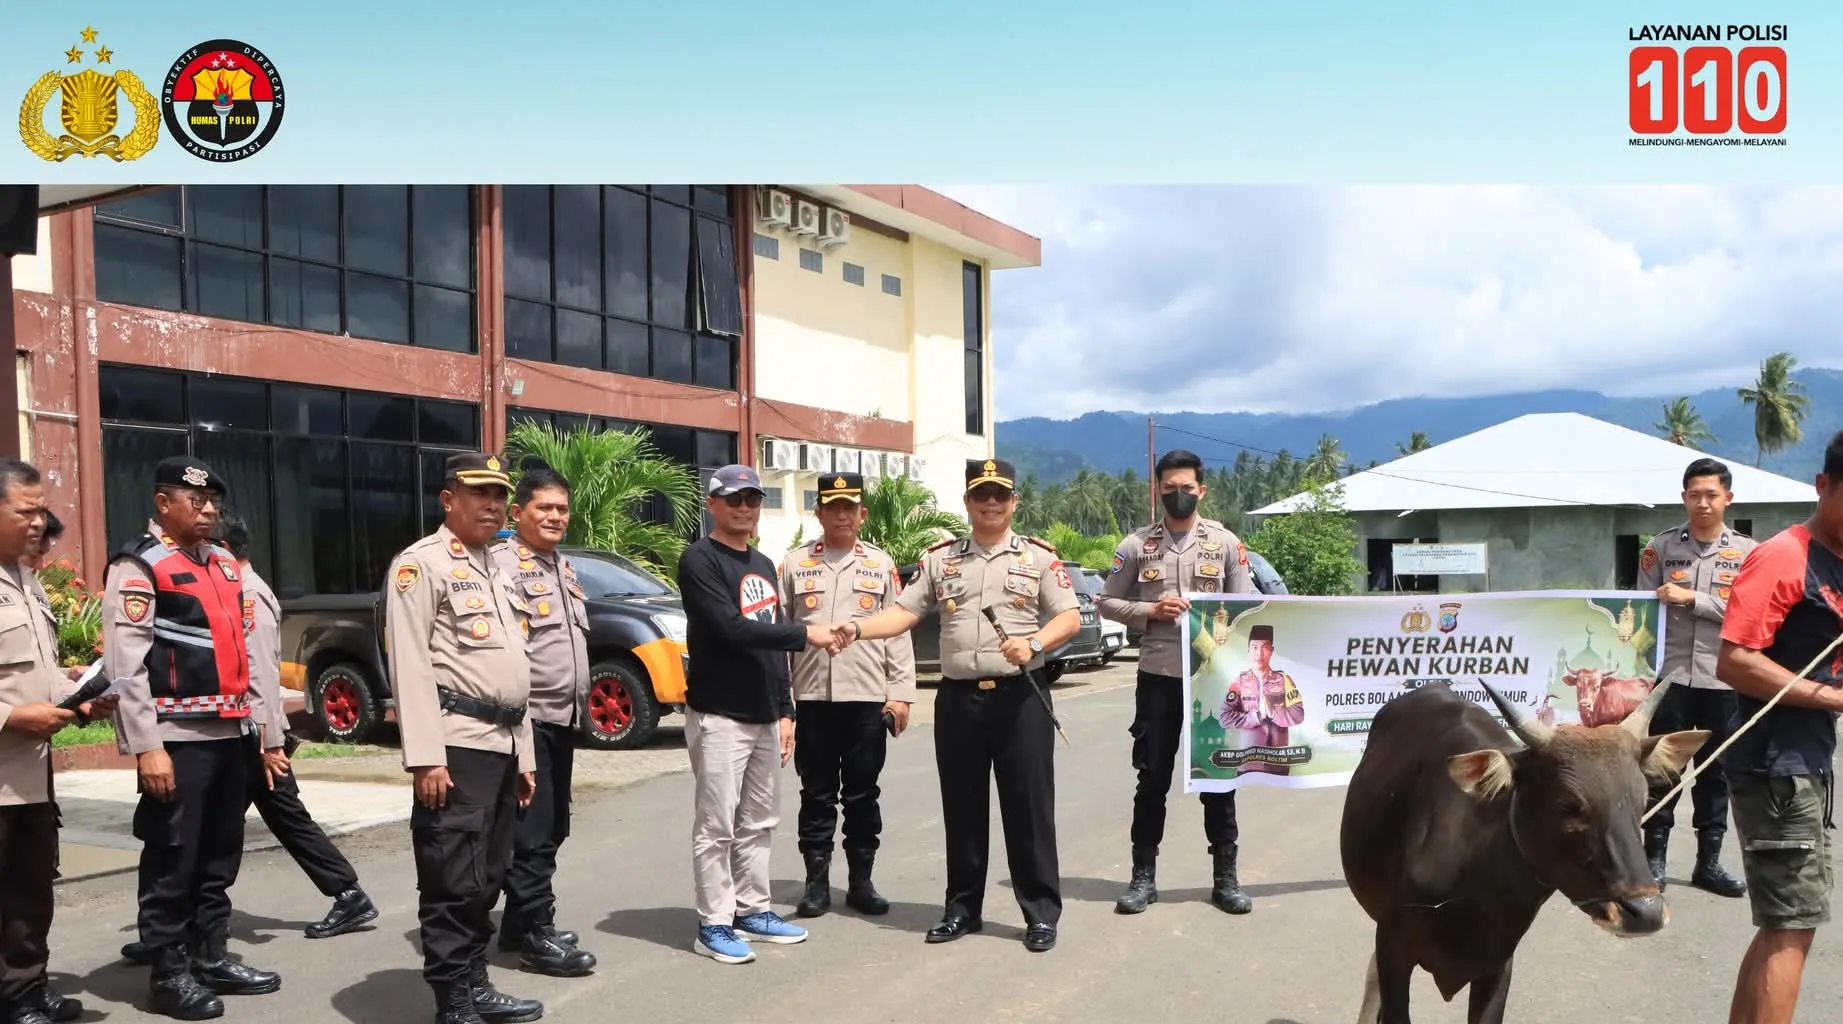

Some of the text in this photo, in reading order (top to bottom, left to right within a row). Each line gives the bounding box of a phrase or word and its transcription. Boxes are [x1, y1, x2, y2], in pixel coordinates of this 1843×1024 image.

[1197, 552, 1223, 561] POLRI
[1665, 560, 1740, 569] DEWA POLR
[795, 569, 883, 579] VERRY POLRI
[451, 582, 482, 592] BERTI
[1346, 635, 1513, 656] PENYERAHAN
[1327, 656, 1530, 678] HEWAN KURBAN
[1325, 692, 1365, 706] POLRES
[1334, 721, 1373, 732] HARI RAY
